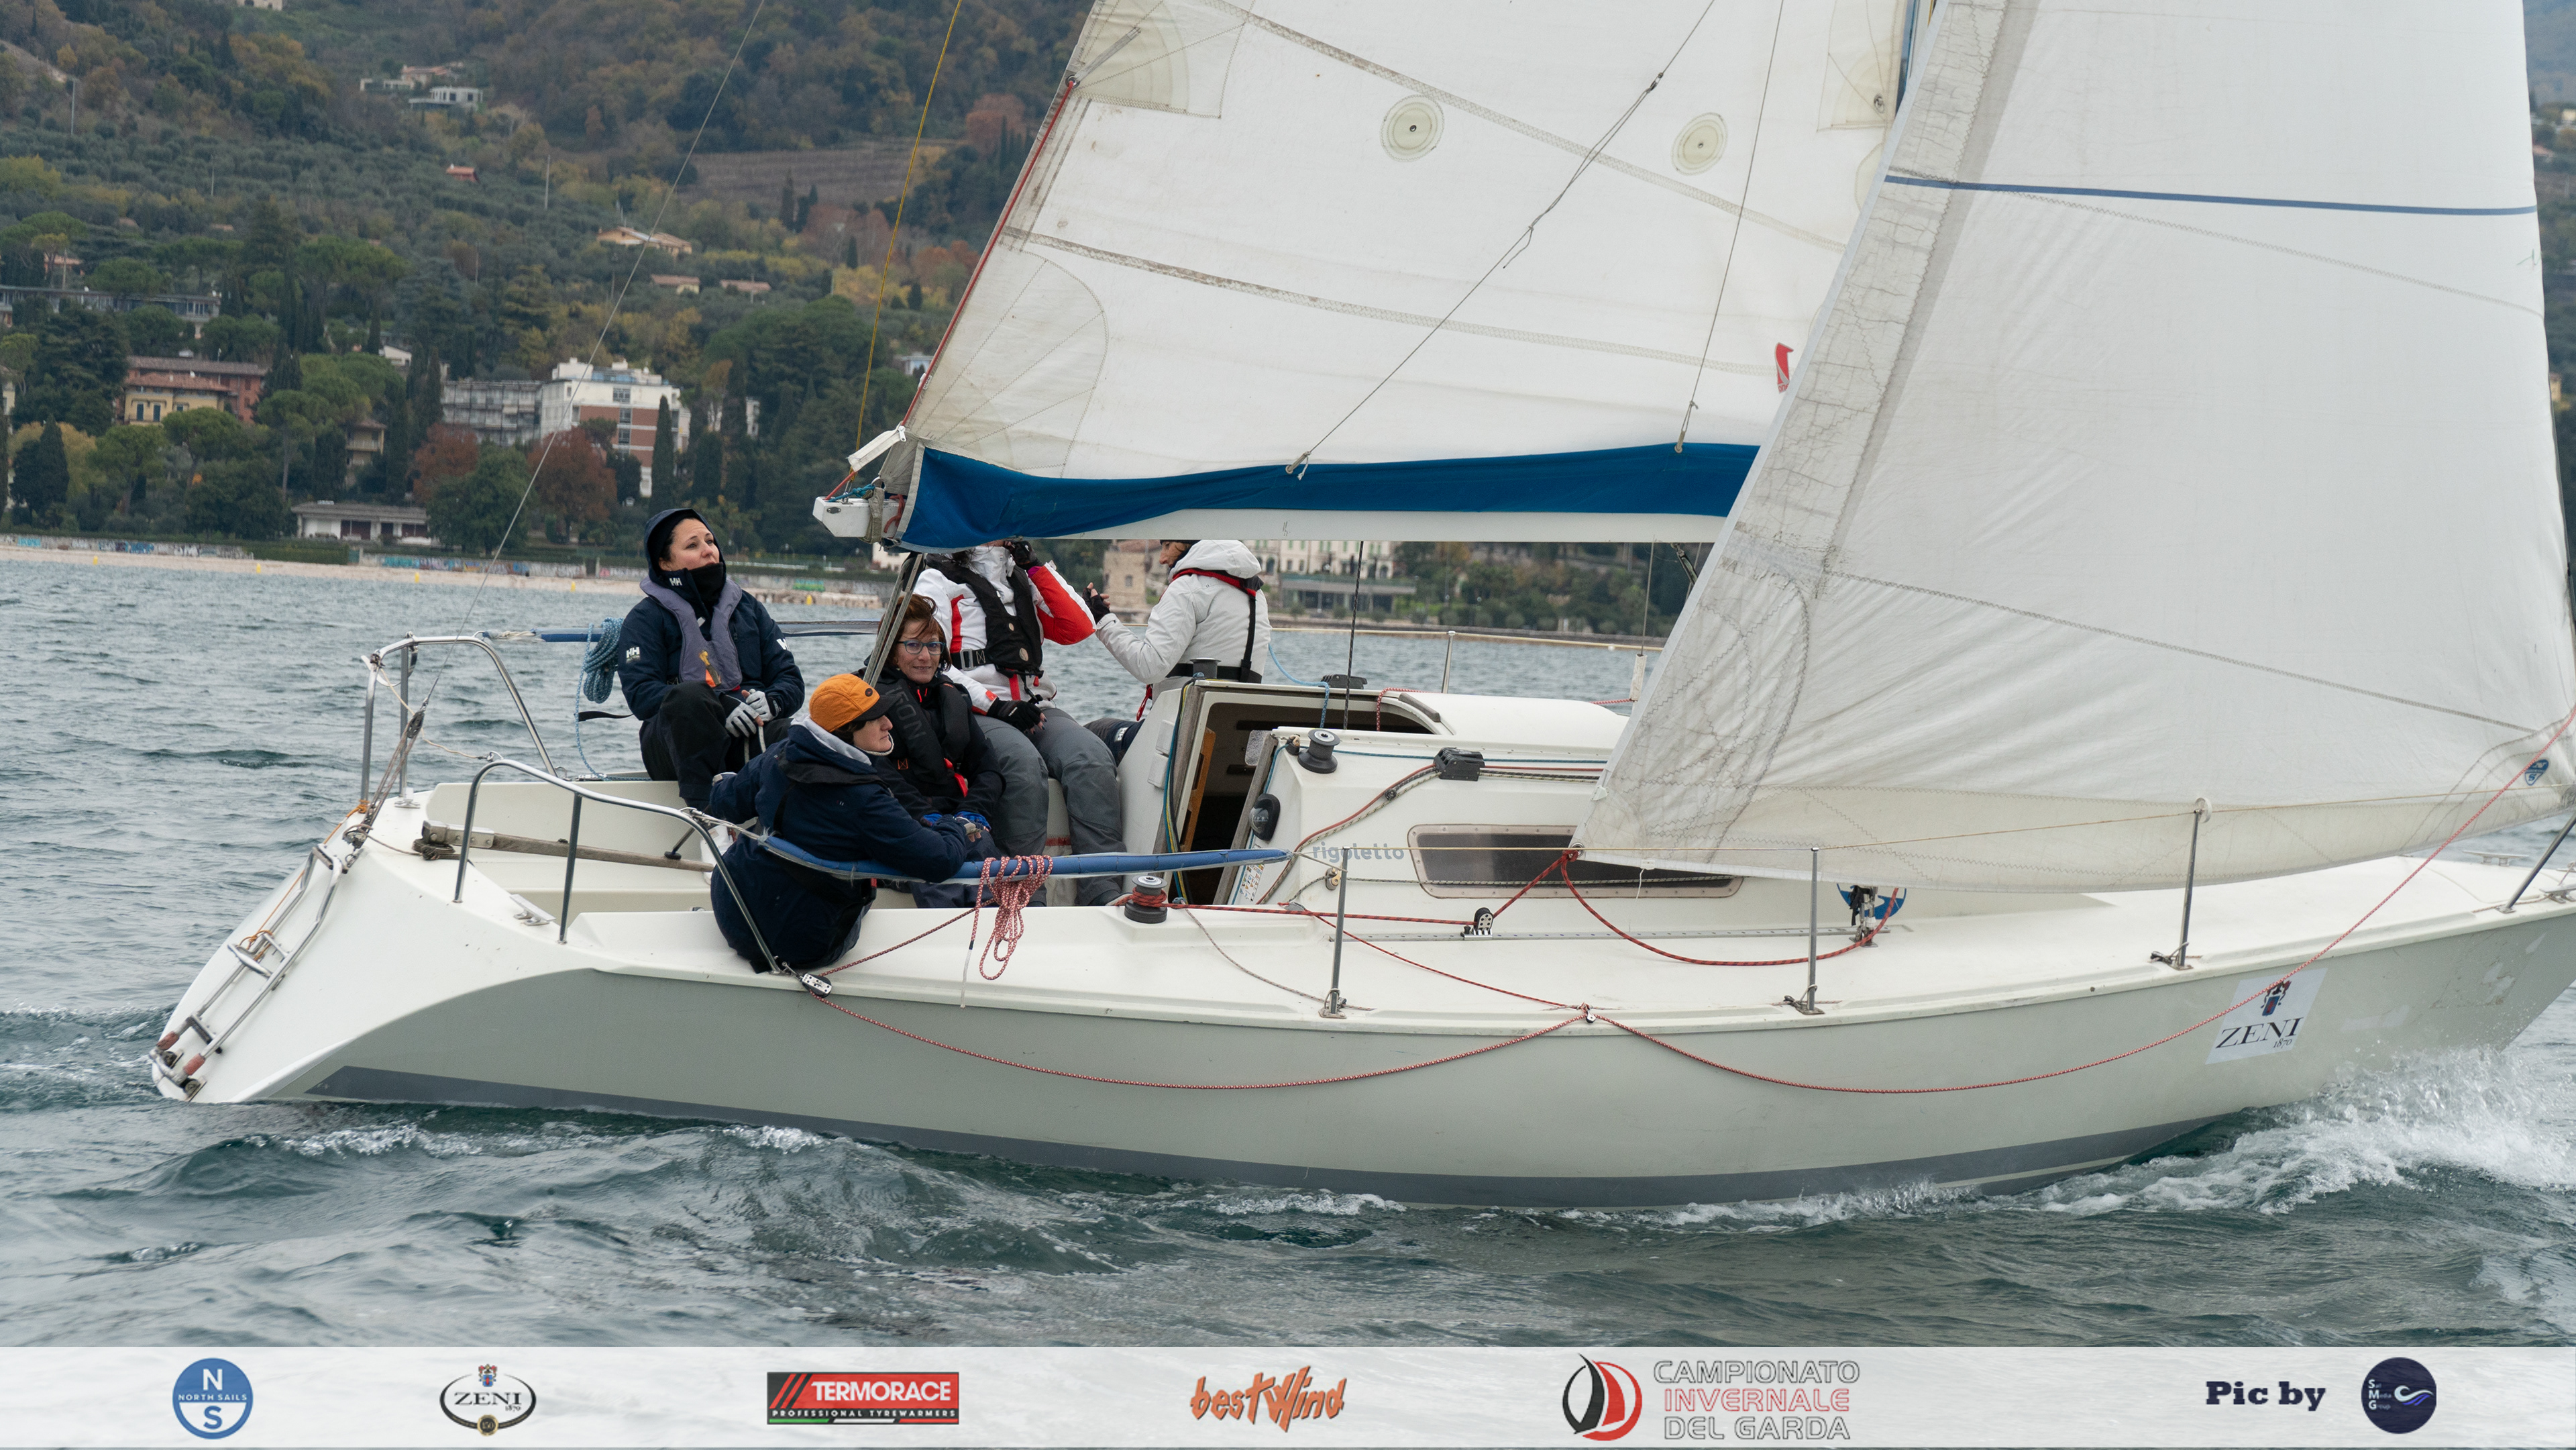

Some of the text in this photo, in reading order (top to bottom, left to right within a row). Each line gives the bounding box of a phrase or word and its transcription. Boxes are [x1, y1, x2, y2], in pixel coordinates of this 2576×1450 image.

[669, 577, 683, 586] HH
[776, 638, 791, 652] H
[626, 646, 640, 658] HH
[1313, 841, 1405, 864] rigoletto
[2216, 1017, 2304, 1049] ZENI
[2273, 1038, 2293, 1049] 1870
